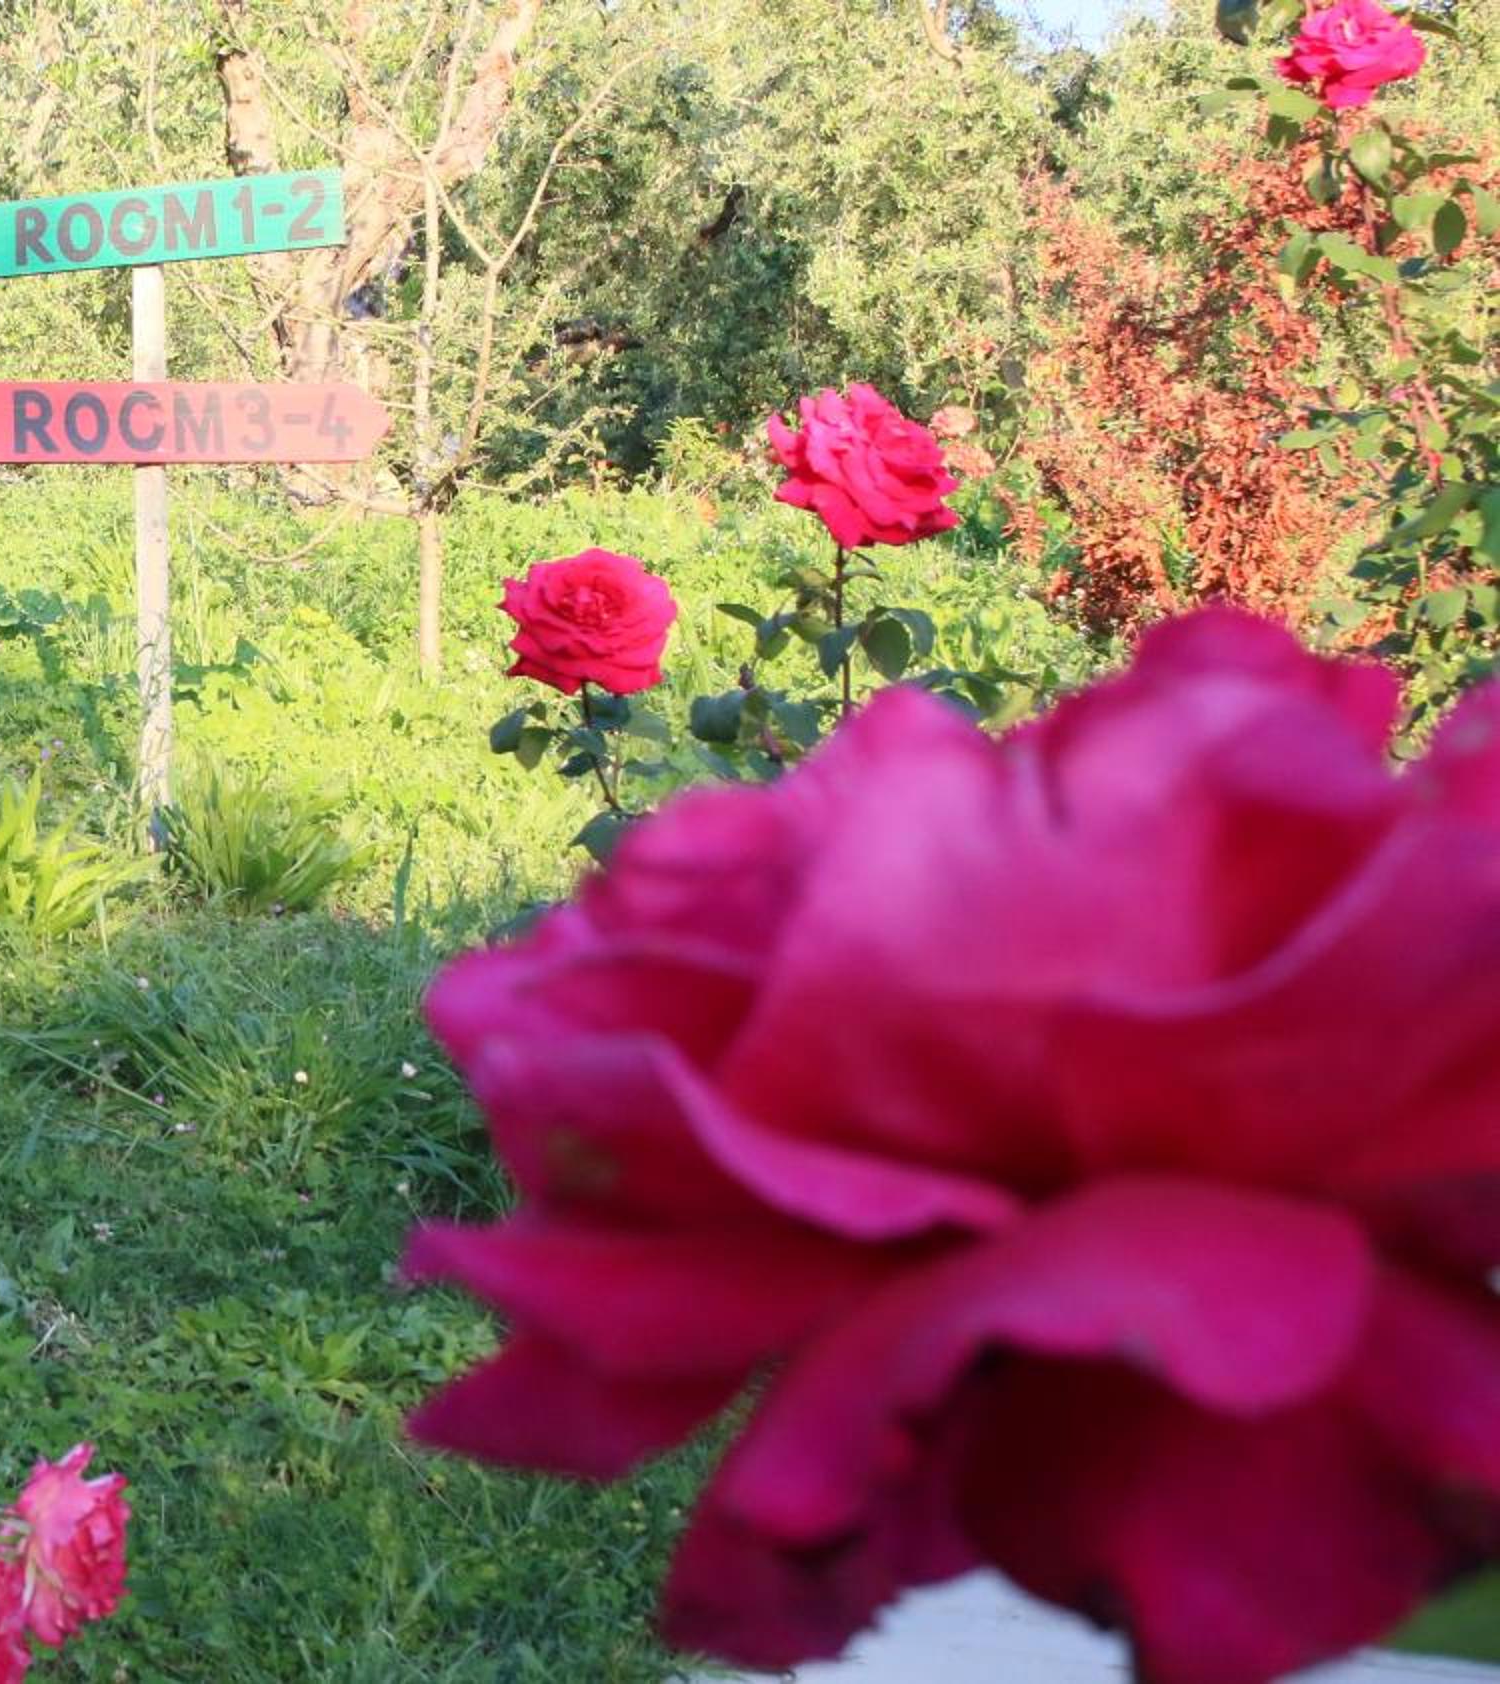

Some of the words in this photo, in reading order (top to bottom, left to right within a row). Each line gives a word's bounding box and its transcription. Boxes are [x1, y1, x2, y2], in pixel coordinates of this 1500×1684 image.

[14, 189, 217, 267] ROOM
[231, 179, 326, 244] 1-2
[12, 390, 226, 455] ROOM
[240, 389, 354, 455] 3-4
